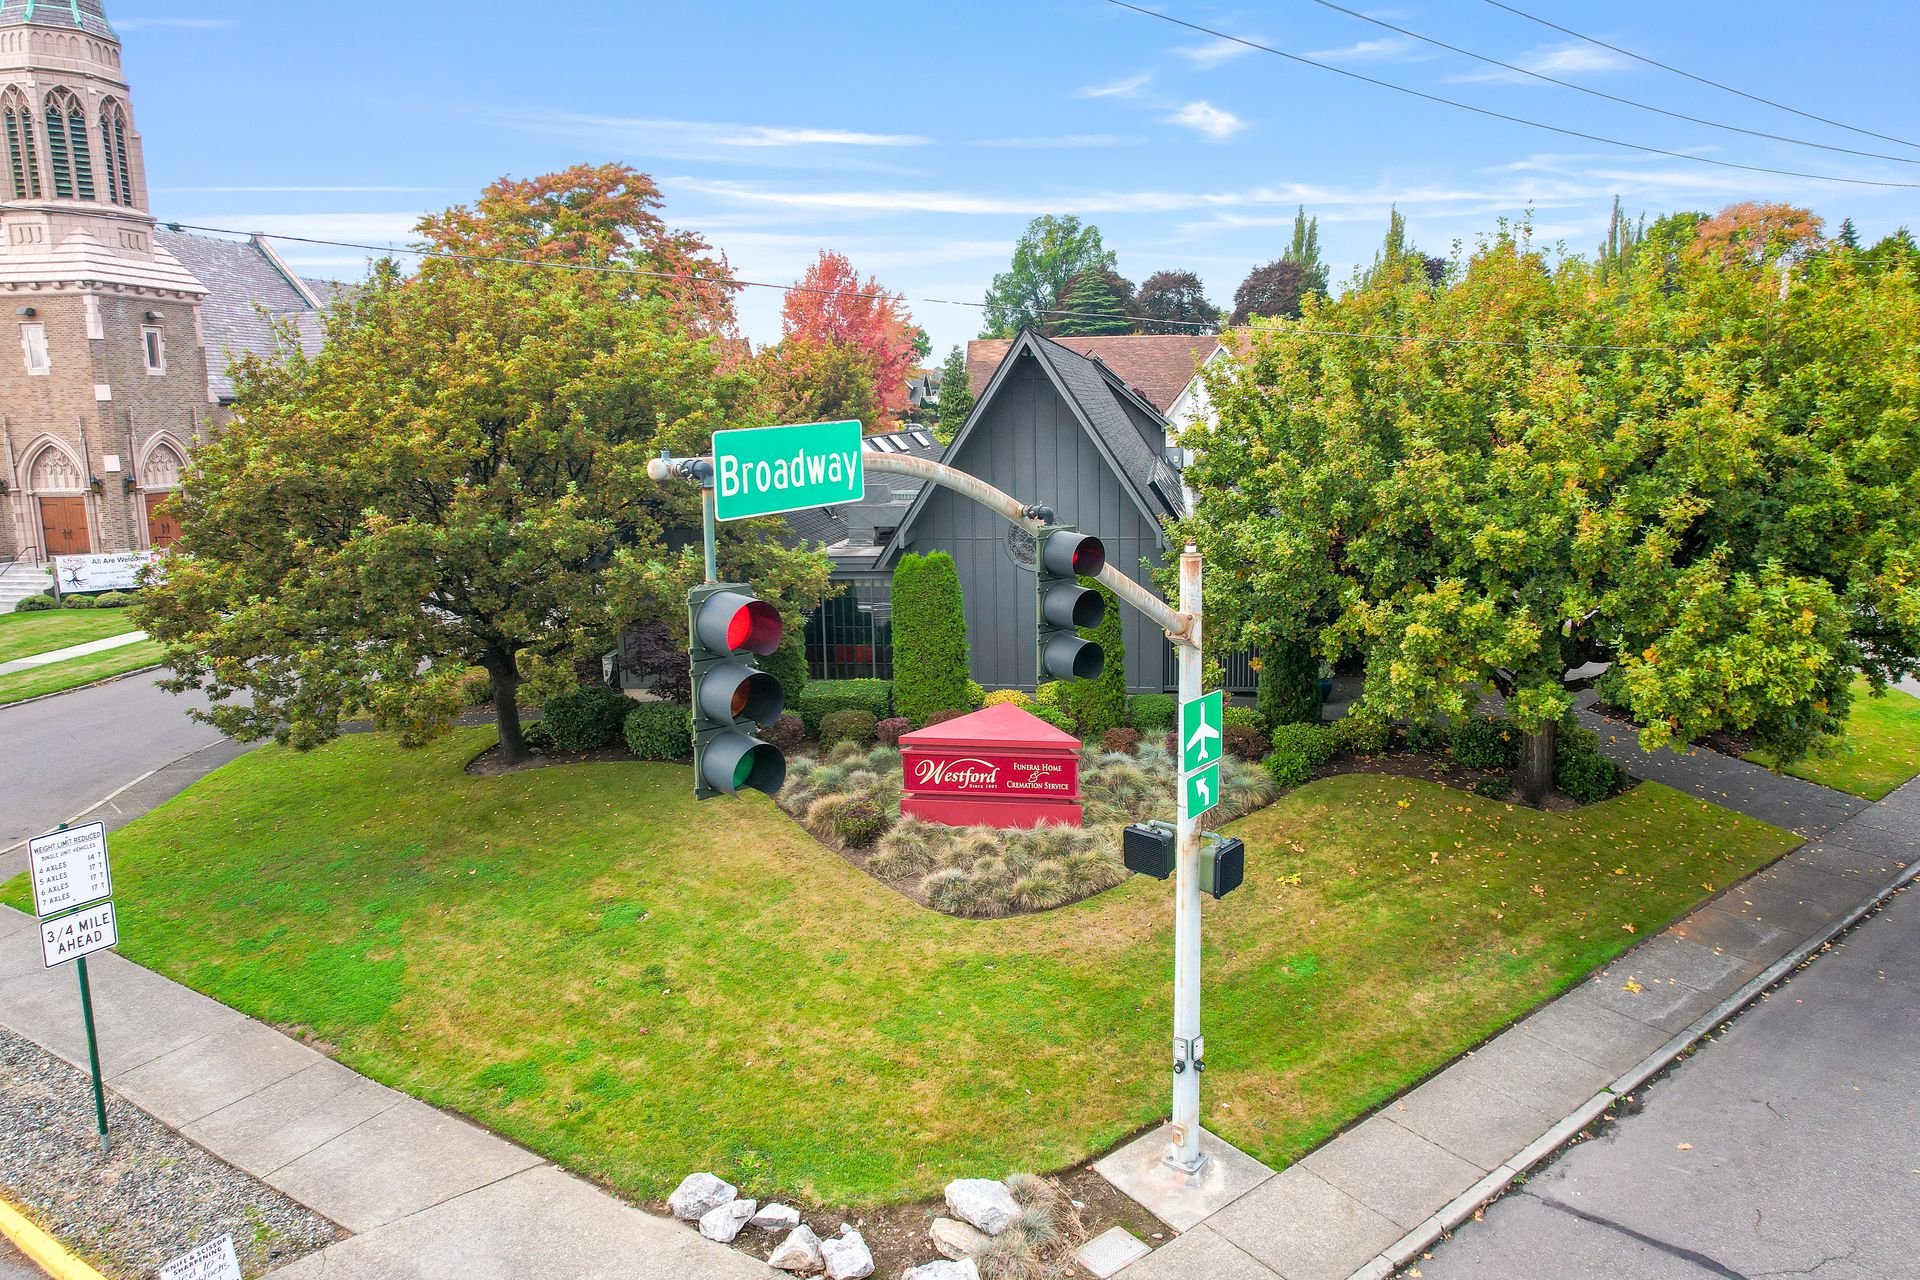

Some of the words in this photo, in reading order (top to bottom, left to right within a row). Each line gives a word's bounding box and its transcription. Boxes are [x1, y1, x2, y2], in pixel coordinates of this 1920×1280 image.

[720, 448, 858, 497] Broadway
[117, 555, 149, 563] Welcome
[914, 758, 1001, 789] Westford
[1013, 762, 1040, 771] FUNERAL
[1041, 763, 1062, 772] HOME
[1006, 780, 1043, 790] CREMATION
[1044, 781, 1069, 791] SERVICE
[34, 843, 56, 855] WEIGHT
[57, 838, 72, 848] LIMIT
[73, 831, 101, 843] REDUCED
[41, 852, 59, 862] SINGLE
[60, 848, 71, 857] UNIT
[73, 842, 97, 853] VEHICLES
[46, 861, 67, 872] AXLES
[87, 853, 95, 861] 14
[46, 871, 68, 883] AXLES
[89, 863, 96, 871] 17
[48, 882, 69, 894] AXLES
[90, 873, 97, 881] 17
[49, 892, 71, 904] AXLES
[91, 883, 98, 891] 17
[47, 924, 74, 943] 3/4
[79, 912, 111, 933] MILE
[58, 930, 102, 955] AHEAD
[164, 1257, 187, 1273] KNIFE
[196, 1237, 227, 1256] SCISSOR
[173, 1246, 223, 1276] SHARPENING
